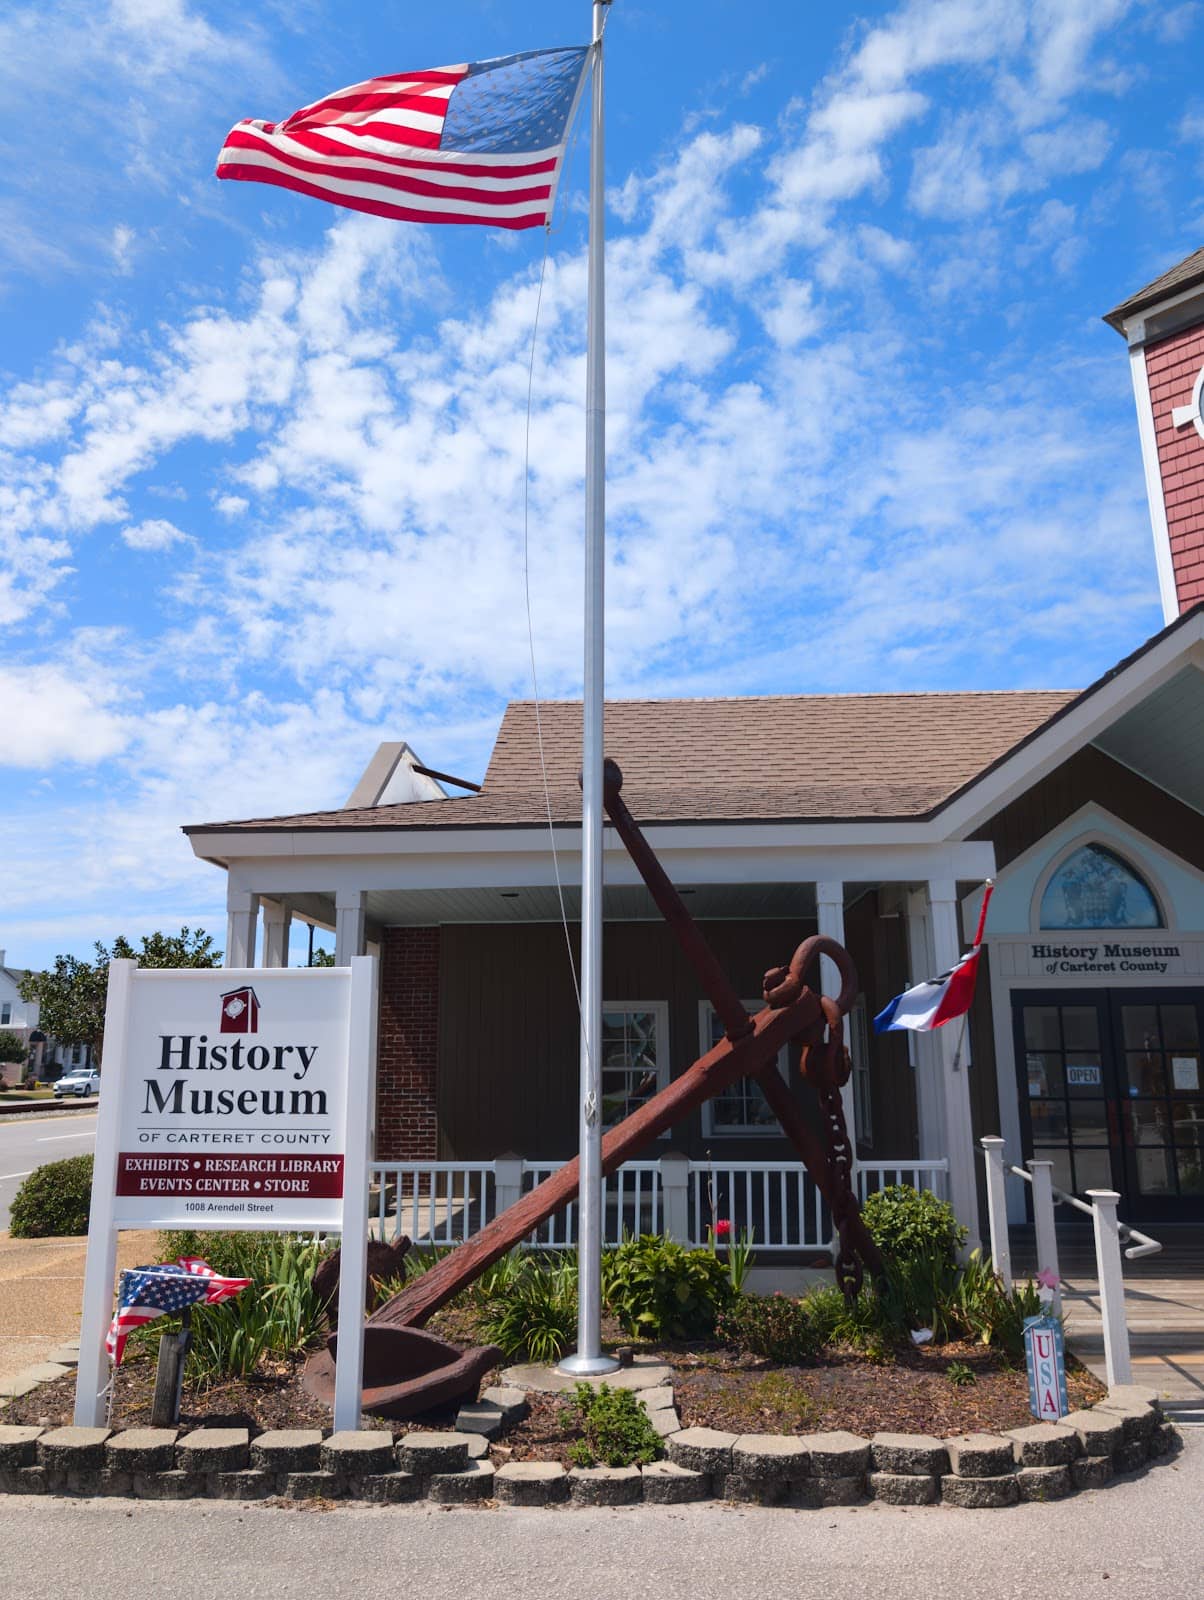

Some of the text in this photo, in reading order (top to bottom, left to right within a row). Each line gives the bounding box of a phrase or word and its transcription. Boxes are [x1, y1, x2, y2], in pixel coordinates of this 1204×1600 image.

[1031, 943, 1181, 960] History Museum
[1046, 960, 1169, 974] of Carteret County
[155, 1034, 319, 1080] History
[1069, 1068, 1099, 1082] OPEN
[140, 1078, 329, 1115] Museum
[138, 1132, 331, 1145] OF CARTERET COUNTY
[125, 1158, 342, 1174] EXHIBITS RESEARCH LIBRARY
[139, 1177, 310, 1192] EVENTS CENTER STORE
[184, 1202, 274, 1212] 1008 Arendell Street
[1036, 1335, 1057, 1413] USA
